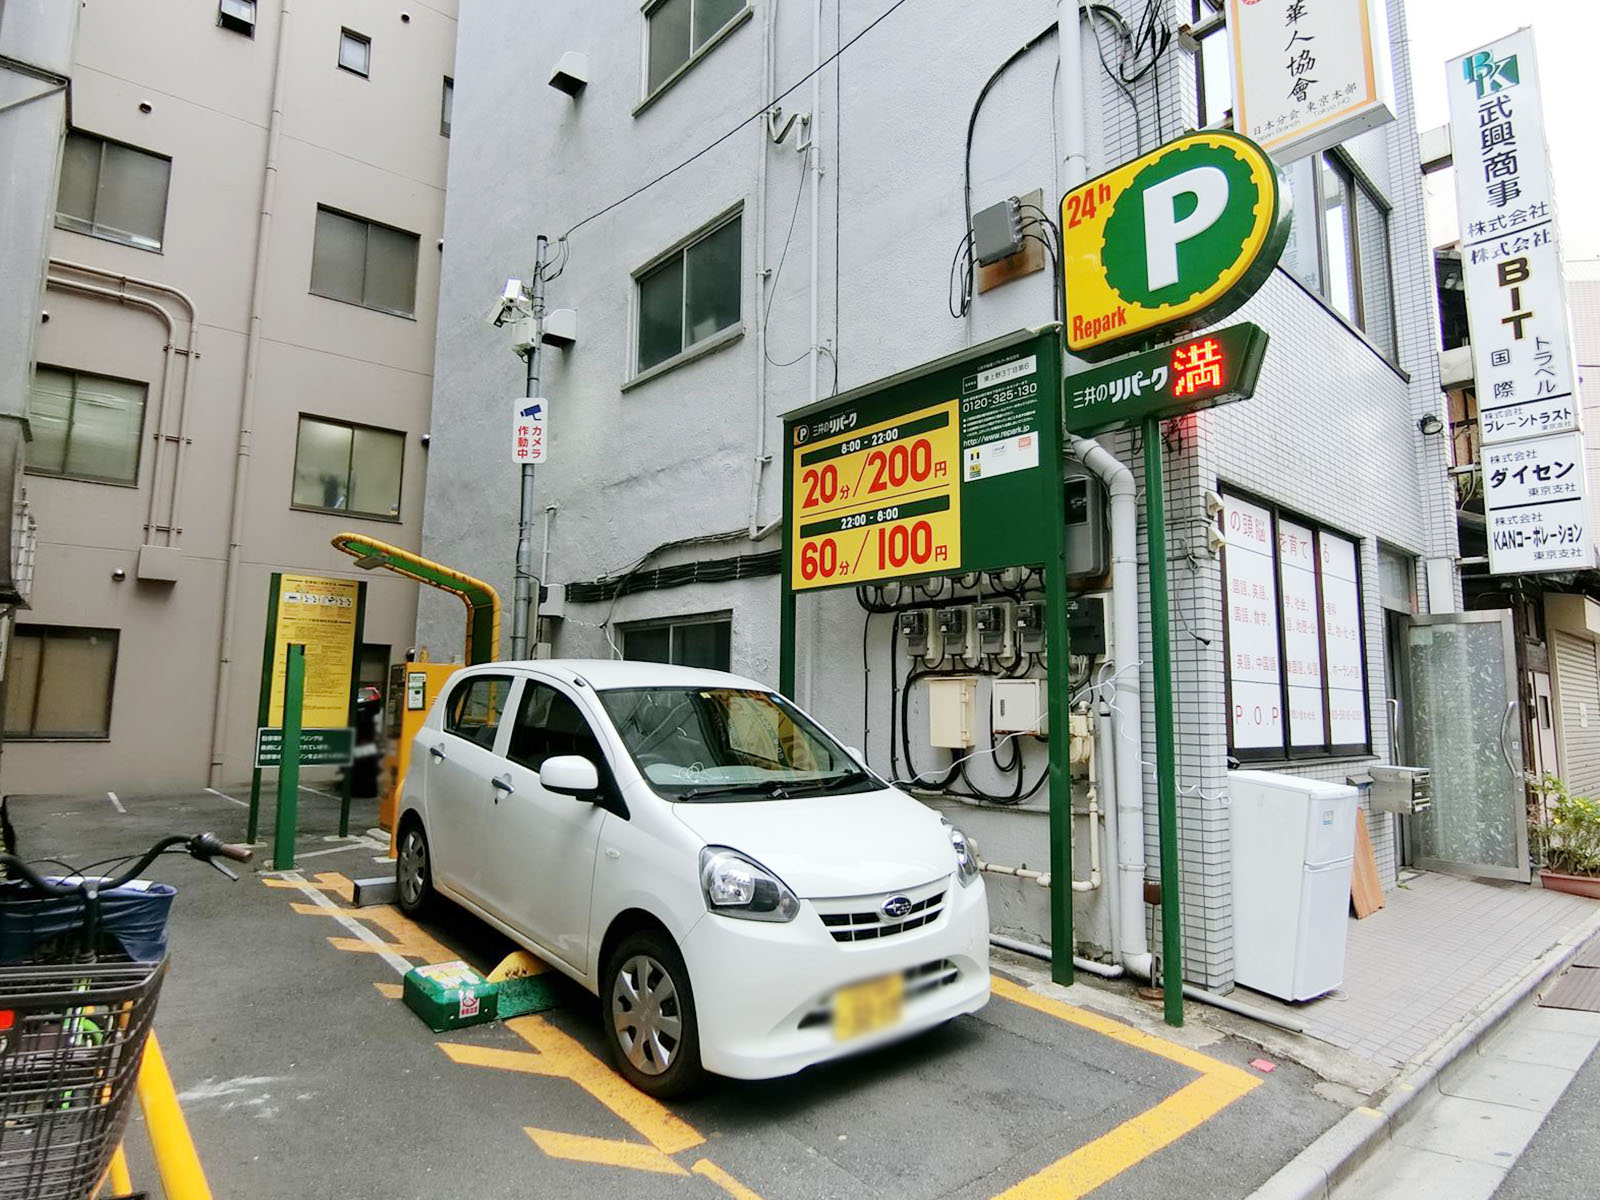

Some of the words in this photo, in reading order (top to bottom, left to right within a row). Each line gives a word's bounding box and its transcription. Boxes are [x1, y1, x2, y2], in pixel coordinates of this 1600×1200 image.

[1478, 95, 1522, 208] 武興商事
[1143, 166, 1229, 292] P
[1468, 201, 1549, 238] 株式会社
[1471, 228, 1552, 264] 株式会社
[1497, 257, 1533, 340] BIT
[1073, 306, 1127, 342] Repark
[1174, 340, 1222, 396] 満
[1534, 336, 1558, 396] トラベル
[963, 383, 1037, 412] 0120-325-130
[1073, 365, 1168, 409] 三井のリパーク
[813, 412, 857, 437] 三井のリパーク
[1485, 407, 1523, 420] 株式会社
[518, 425, 529, 459] 作動中
[532, 426, 542, 459] カメラ
[841, 439, 860, 454] 8:00
[872, 428, 898, 446] 22:00
[1490, 450, 1538, 464] 株式会社
[1490, 461, 1575, 489] ダイセン
[1528, 483, 1577, 498] 東京支社
[841, 515, 866, 530] 22:00
[877, 507, 899, 521] 8:00
[1495, 512, 1543, 526] 株式会社
[1493, 524, 1583, 551] KANコーポレーション
[1534, 548, 1583, 561] 東京支社
